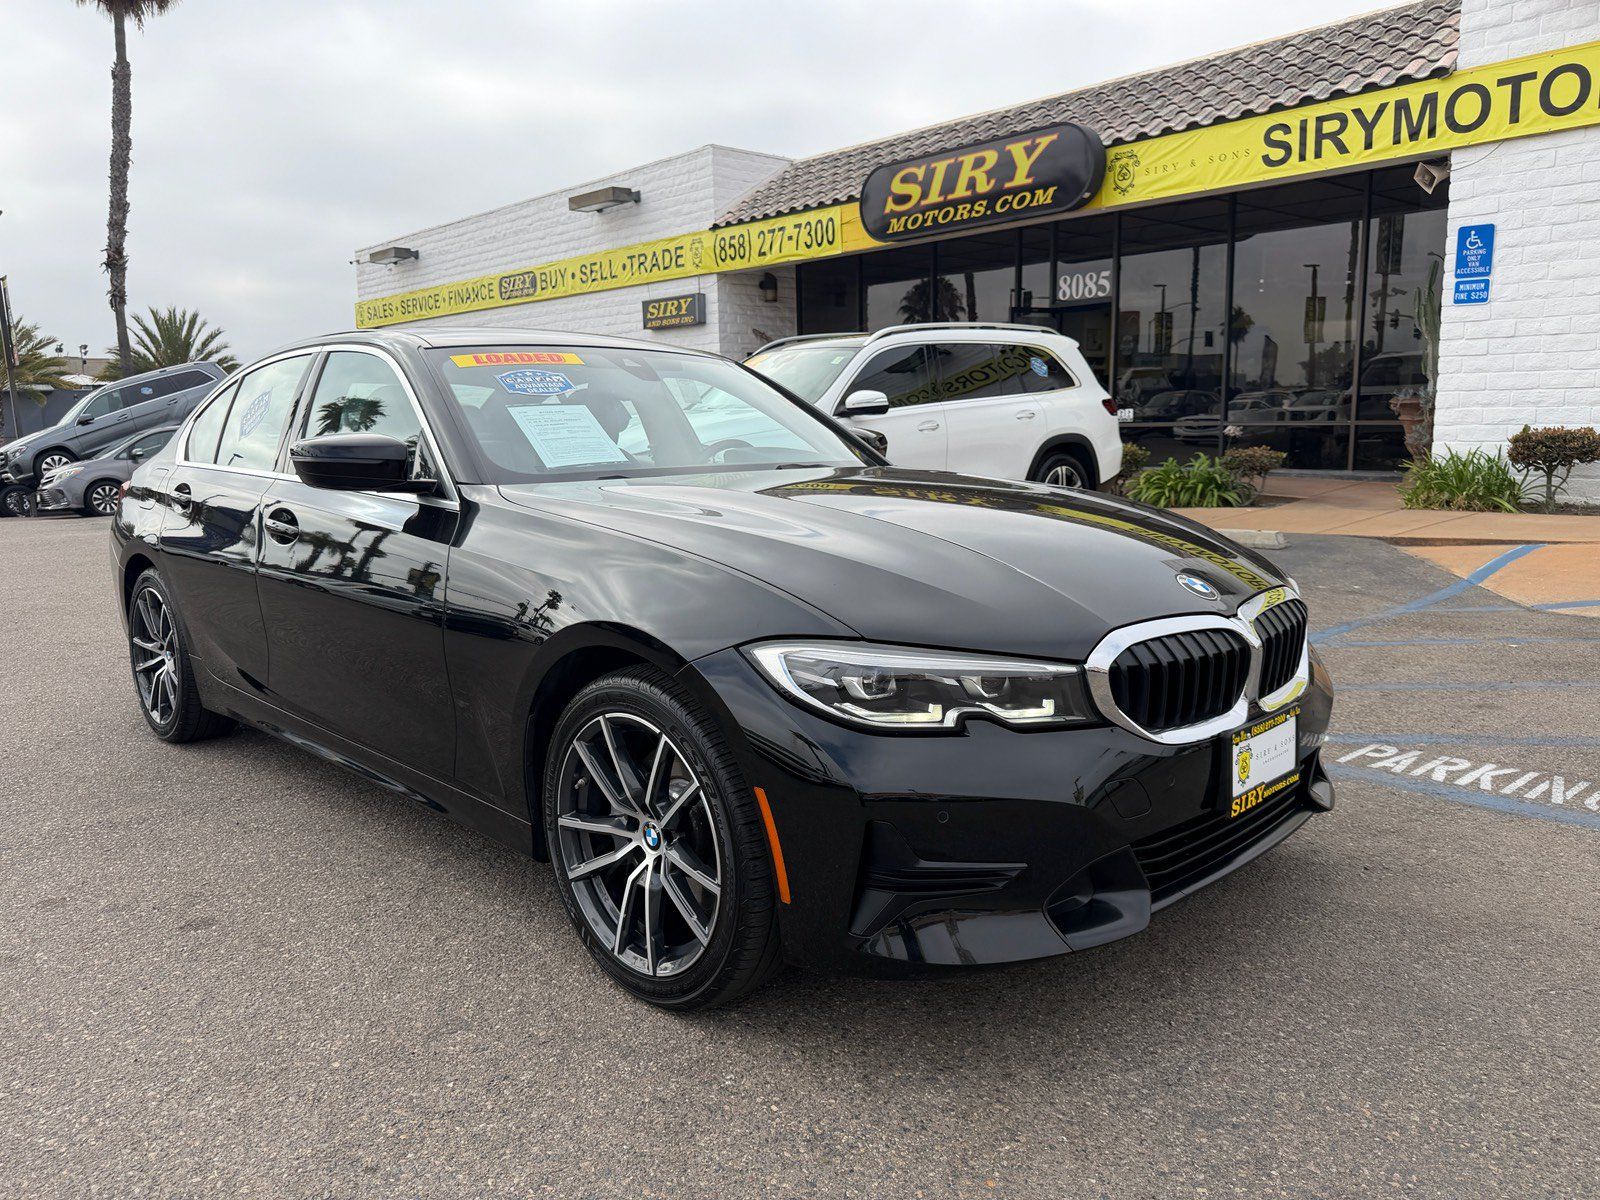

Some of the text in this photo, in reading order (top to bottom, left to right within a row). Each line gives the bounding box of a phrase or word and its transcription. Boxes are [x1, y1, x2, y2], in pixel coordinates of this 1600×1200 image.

[1261, 62, 1600, 168] SIRYMOTO
[883, 132, 1059, 216] SIRY
[1145, 148, 1251, 176] SIRY & SONS
[886, 186, 1058, 235] MOTORS.COM
[713, 217, 836, 267] (858) 277-7300
[501, 273, 533, 292] SIRY
[539, 246, 685, 291] BUY SELL TRADE
[1457, 266, 1489, 274] ACCESSIBLE
[1058, 271, 1111, 301] 8085
[1455, 291, 1487, 300] FINE $250
[1459, 283, 1485, 291] MINIMUM
[367, 283, 495, 321] SALES SERVICE FINANCE
[647, 298, 693, 319] SIRY
[647, 320, 661, 328] AND
[472, 353, 566, 366] LOADED
[1336, 743, 1600, 811] PARKIN
